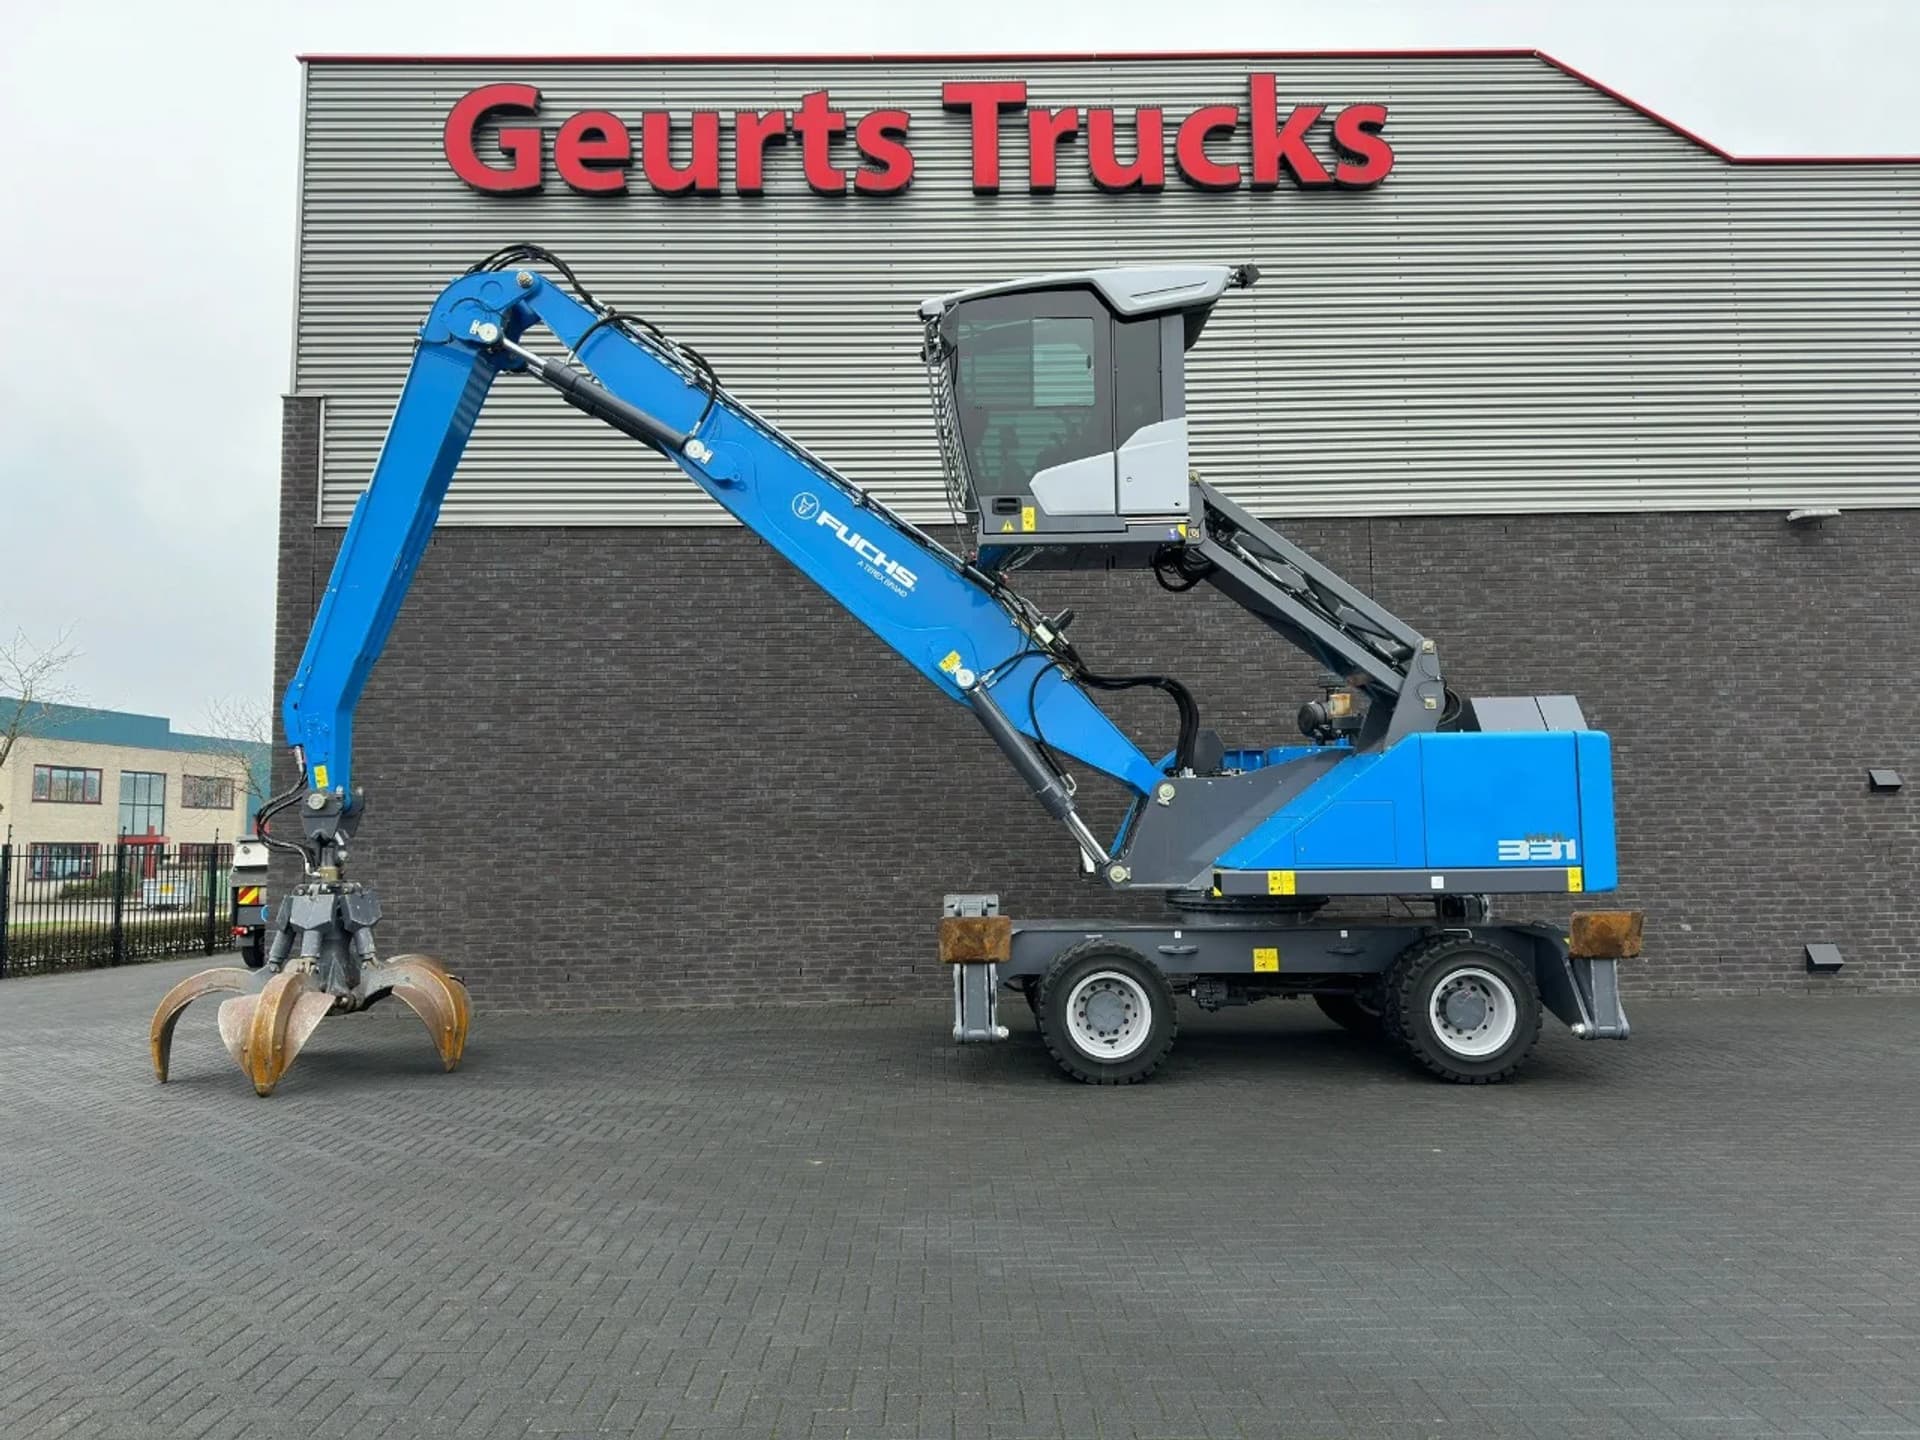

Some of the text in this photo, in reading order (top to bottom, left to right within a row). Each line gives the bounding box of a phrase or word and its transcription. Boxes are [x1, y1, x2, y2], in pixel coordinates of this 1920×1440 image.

[443, 73, 1395, 196] Geurts Trucks
[816, 510, 918, 588] FUCHS
[863, 563, 885, 583] TEREX
[1498, 839, 1577, 861] 331
